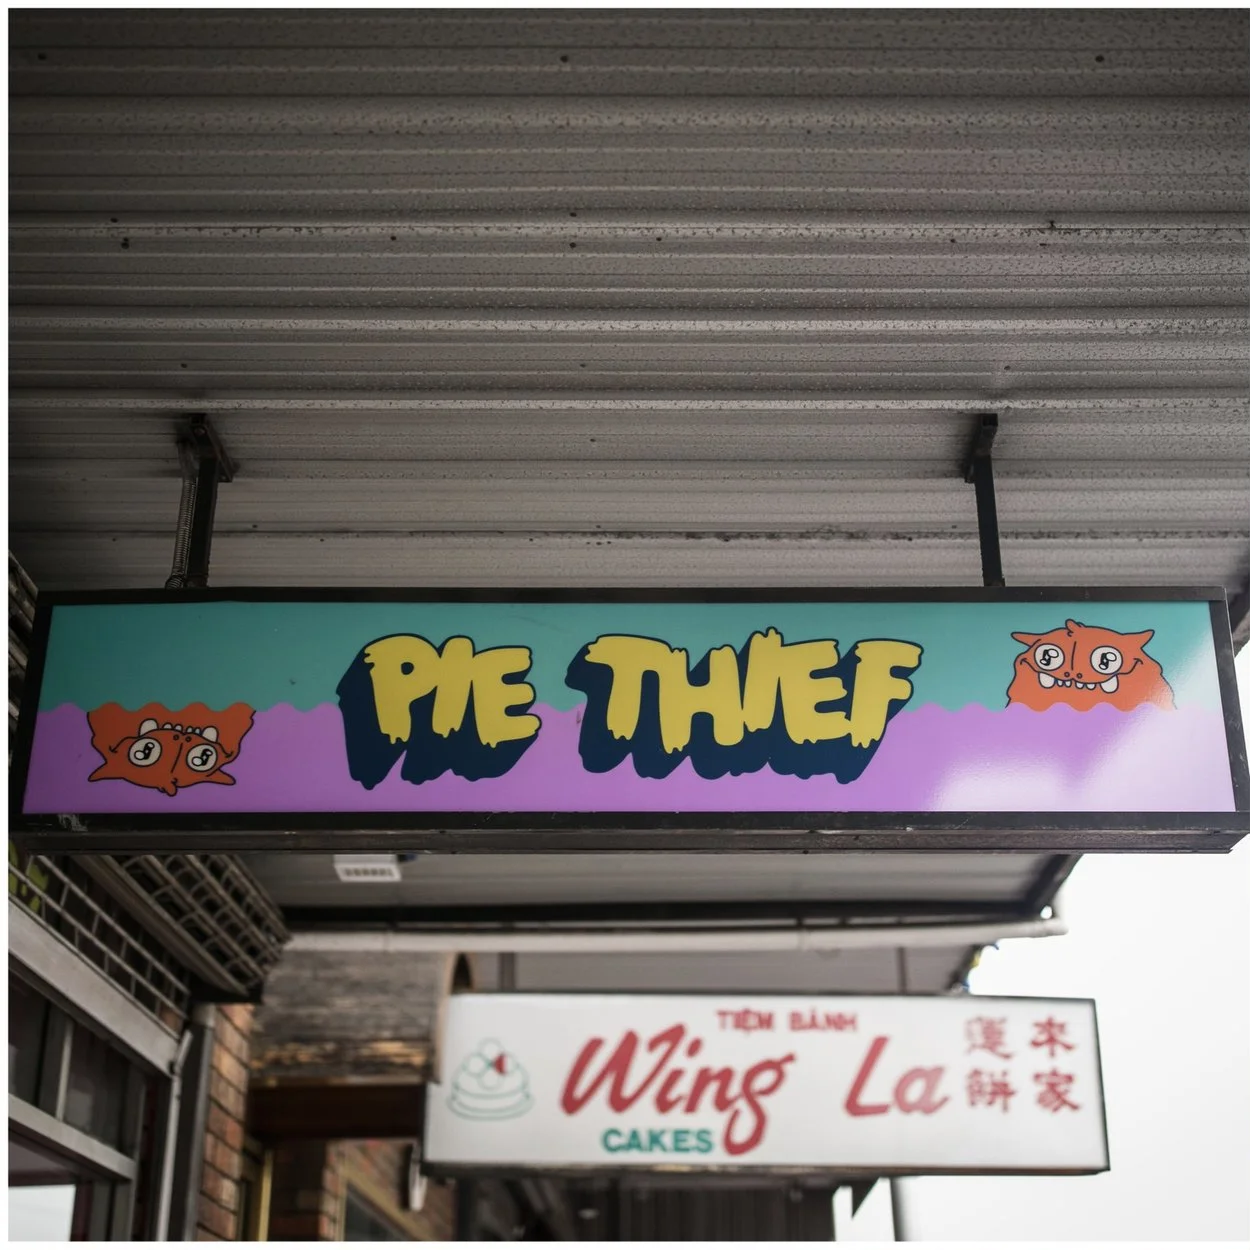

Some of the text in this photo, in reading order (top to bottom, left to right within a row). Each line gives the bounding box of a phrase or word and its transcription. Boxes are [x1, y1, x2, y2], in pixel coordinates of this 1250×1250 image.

[342, 626, 923, 780] PIE THIEF
[558, 1024, 950, 1156] Wing La
[602, 1128, 715, 1154] CAKES
